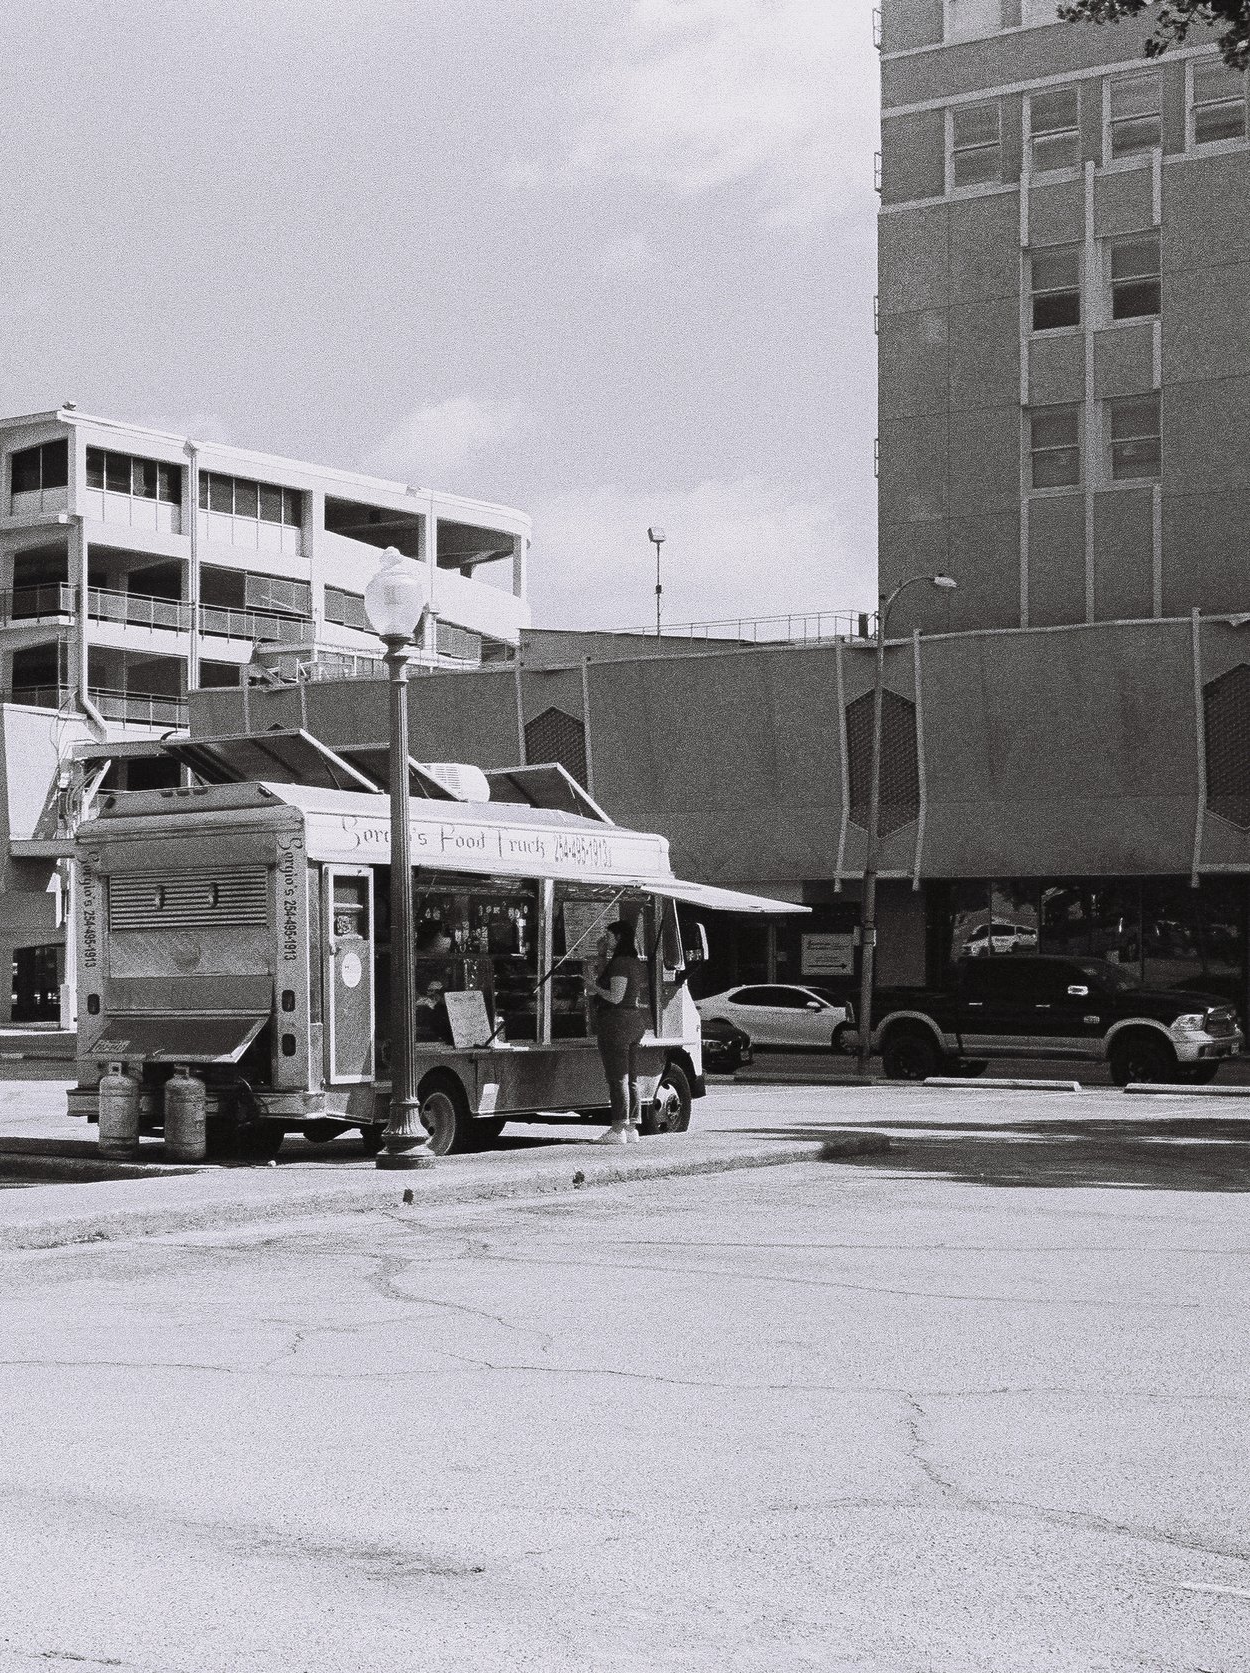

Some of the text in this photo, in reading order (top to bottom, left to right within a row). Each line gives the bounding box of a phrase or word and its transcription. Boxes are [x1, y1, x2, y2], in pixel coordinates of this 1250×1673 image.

[440, 825, 486, 852] Food
[488, 827, 545, 859] Truck
[83, 910, 97, 968] 254-495-1913
[283, 900, 297, 961] 254-495-1913
